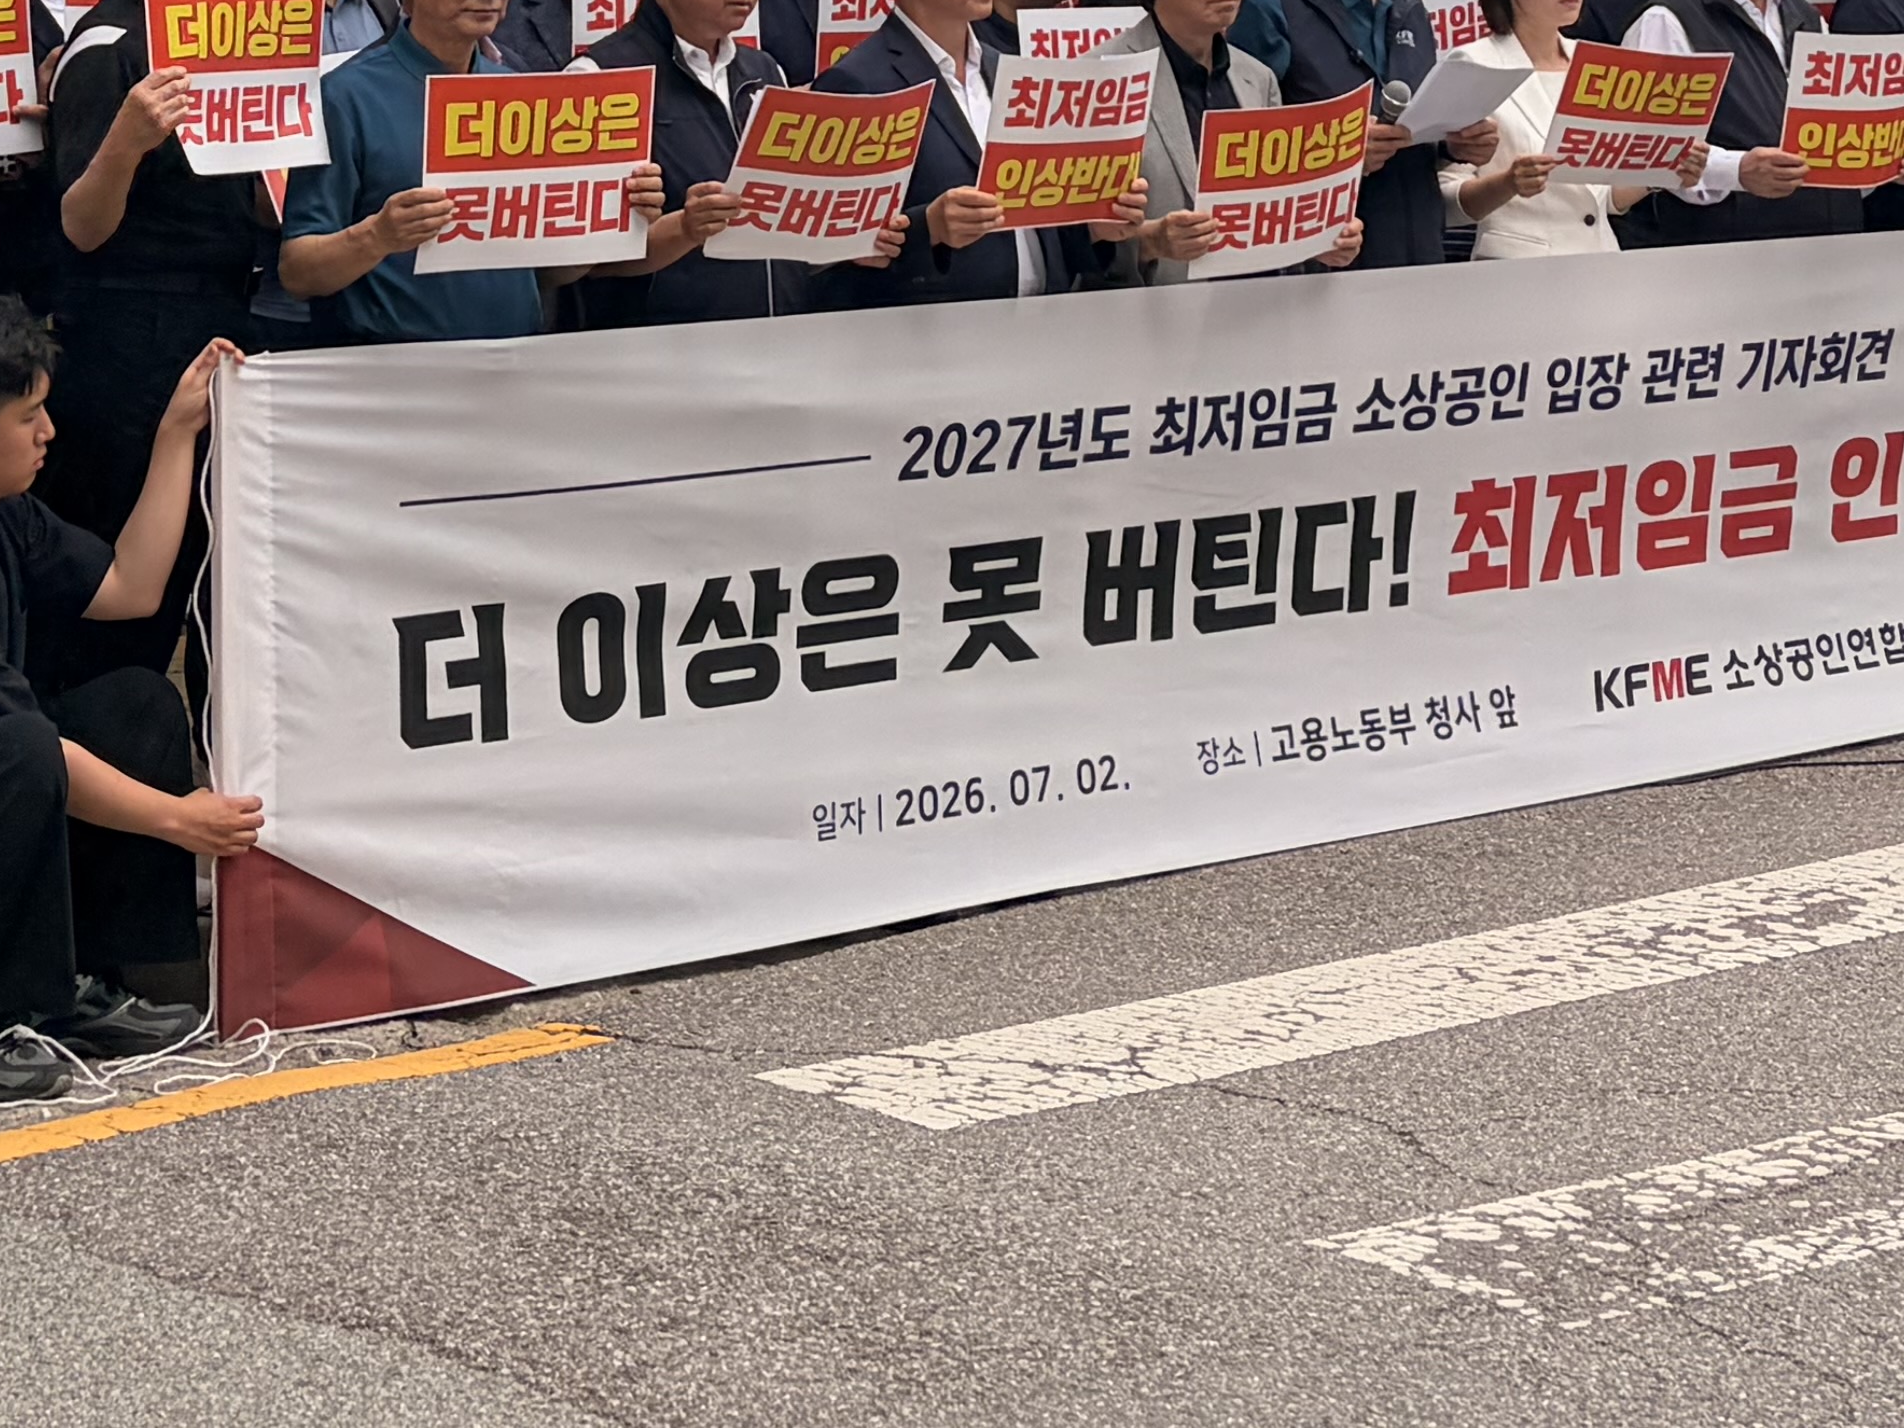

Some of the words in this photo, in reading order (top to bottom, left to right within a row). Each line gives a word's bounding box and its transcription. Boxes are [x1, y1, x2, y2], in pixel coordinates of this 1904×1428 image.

[1004, 71, 1151, 129] 최저임금
[1572, 63, 1717, 116] 더이상은
[444, 92, 641, 159] 더이상은
[757, 106, 921, 166] 더이상은
[1214, 107, 1366, 179] 더이상은
[1554, 127, 1696, 171] 못버틴다
[436, 176, 632, 245] 못버틴다
[727, 181, 902, 238] 못버틴다
[996, 150, 1141, 208] 인상반대
[1207, 177, 1357, 252] 못버틴다
[898, 405, 1132, 482] 2027년도
[1149, 382, 1338, 457] 최저임금
[1352, 361, 1530, 434] 소상공인
[1546, 351, 1630, 415] 입장
[1641, 342, 1724, 404] 관련
[1737, 327, 1896, 393] 기자회견
[392, 602, 509, 749] 더
[556, 553, 900, 724] 이상은
[942, 536, 1044, 673] 못
[1083, 489, 1418, 647] 버틴다!
[1447, 444, 1798, 596] 최저임금
[812, 796, 866, 842] 일자
[896, 775, 997, 828] 2026.
[1008, 765, 1065, 805] 07.
[1076, 754, 1132, 797] 02.
[1196, 738, 1247, 776] 장소
[1271, 701, 1418, 764] 고용노동부
[1424, 689, 1482, 742] 청사
[1489, 683, 1521, 731] 앞
[1594, 652, 1713, 713] KFME
